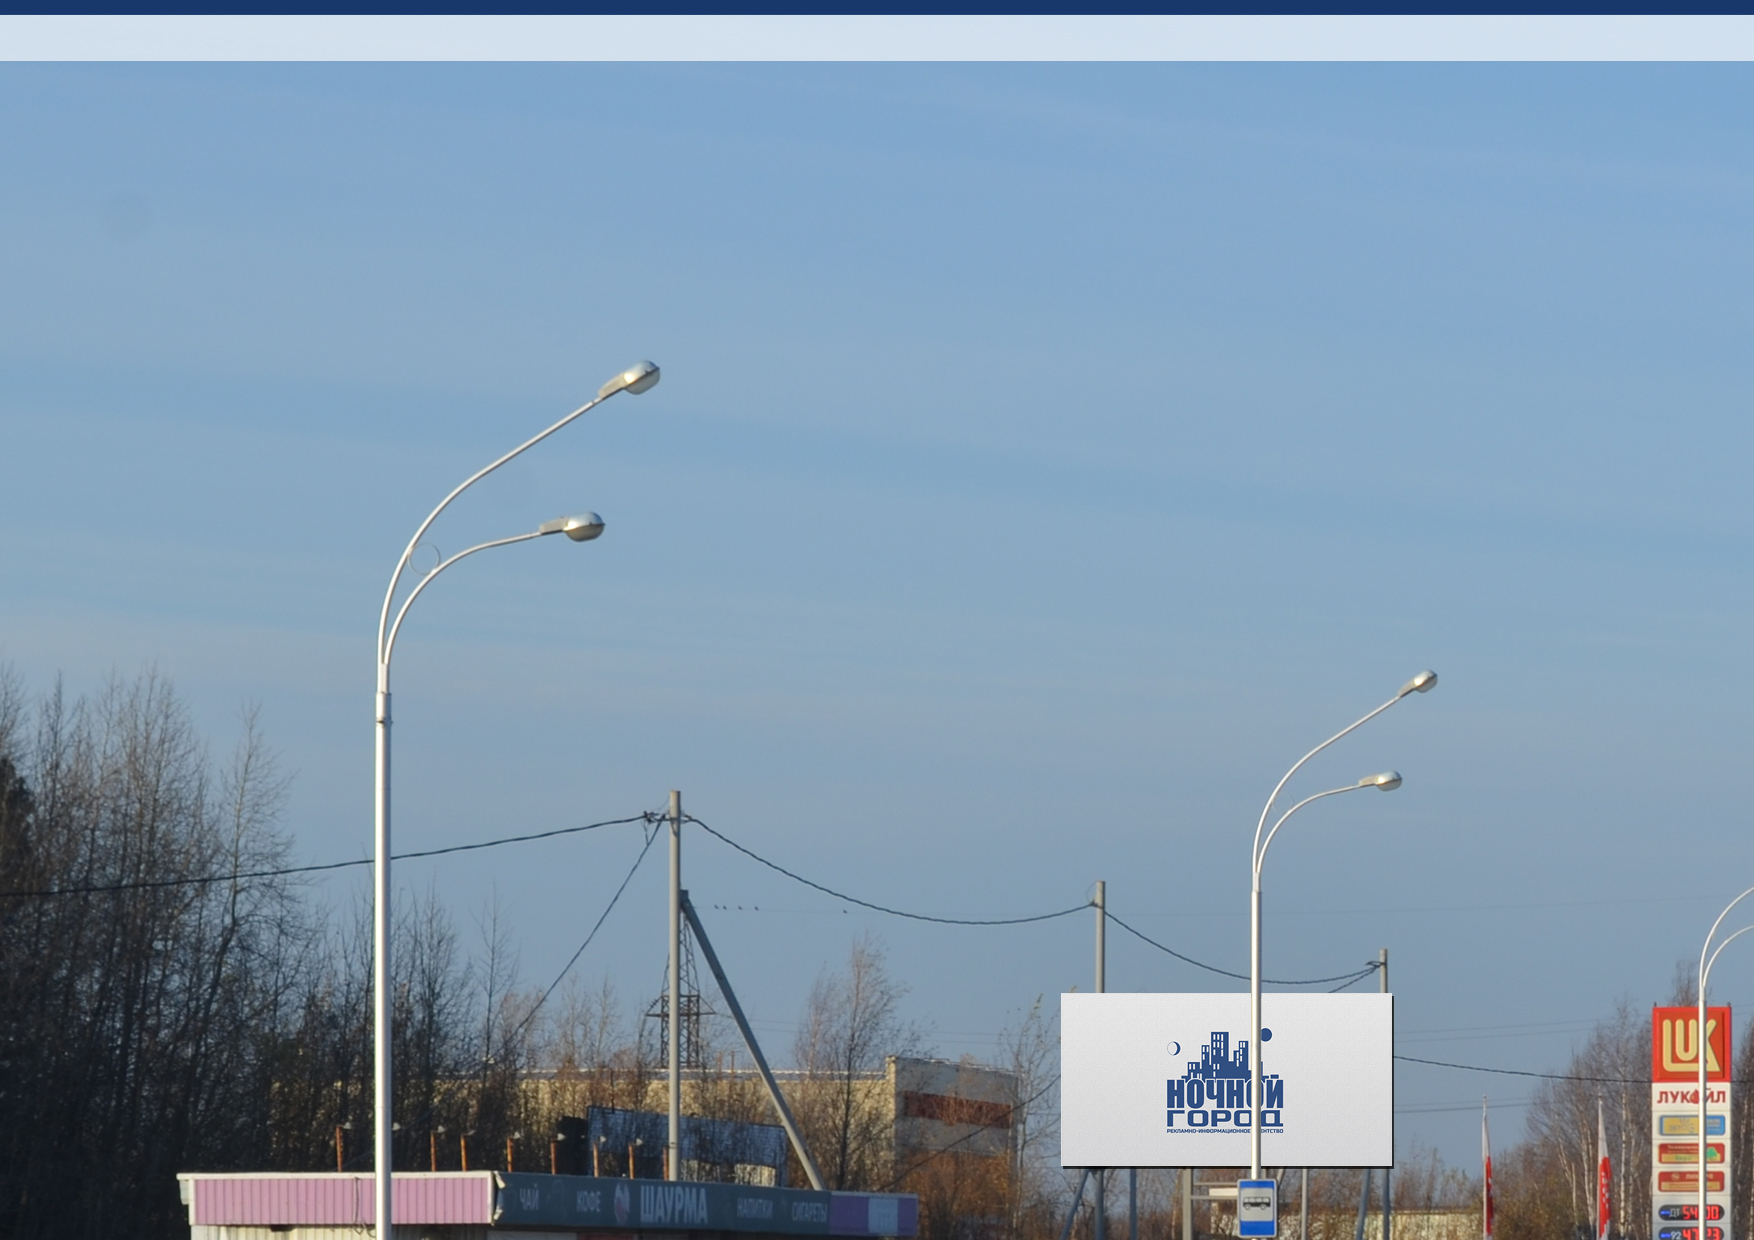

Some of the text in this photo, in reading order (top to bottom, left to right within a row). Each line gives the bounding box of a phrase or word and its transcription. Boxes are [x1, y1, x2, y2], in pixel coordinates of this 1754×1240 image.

[1166, 1109, 1284, 1127] ГОРОД
[519, 1184, 828, 1224] ЧАЙ КОФЕ ШАУРМА НАПИТКИ СИГАРЕТЫ
[1670, 1230, 1681, 1240] 92
